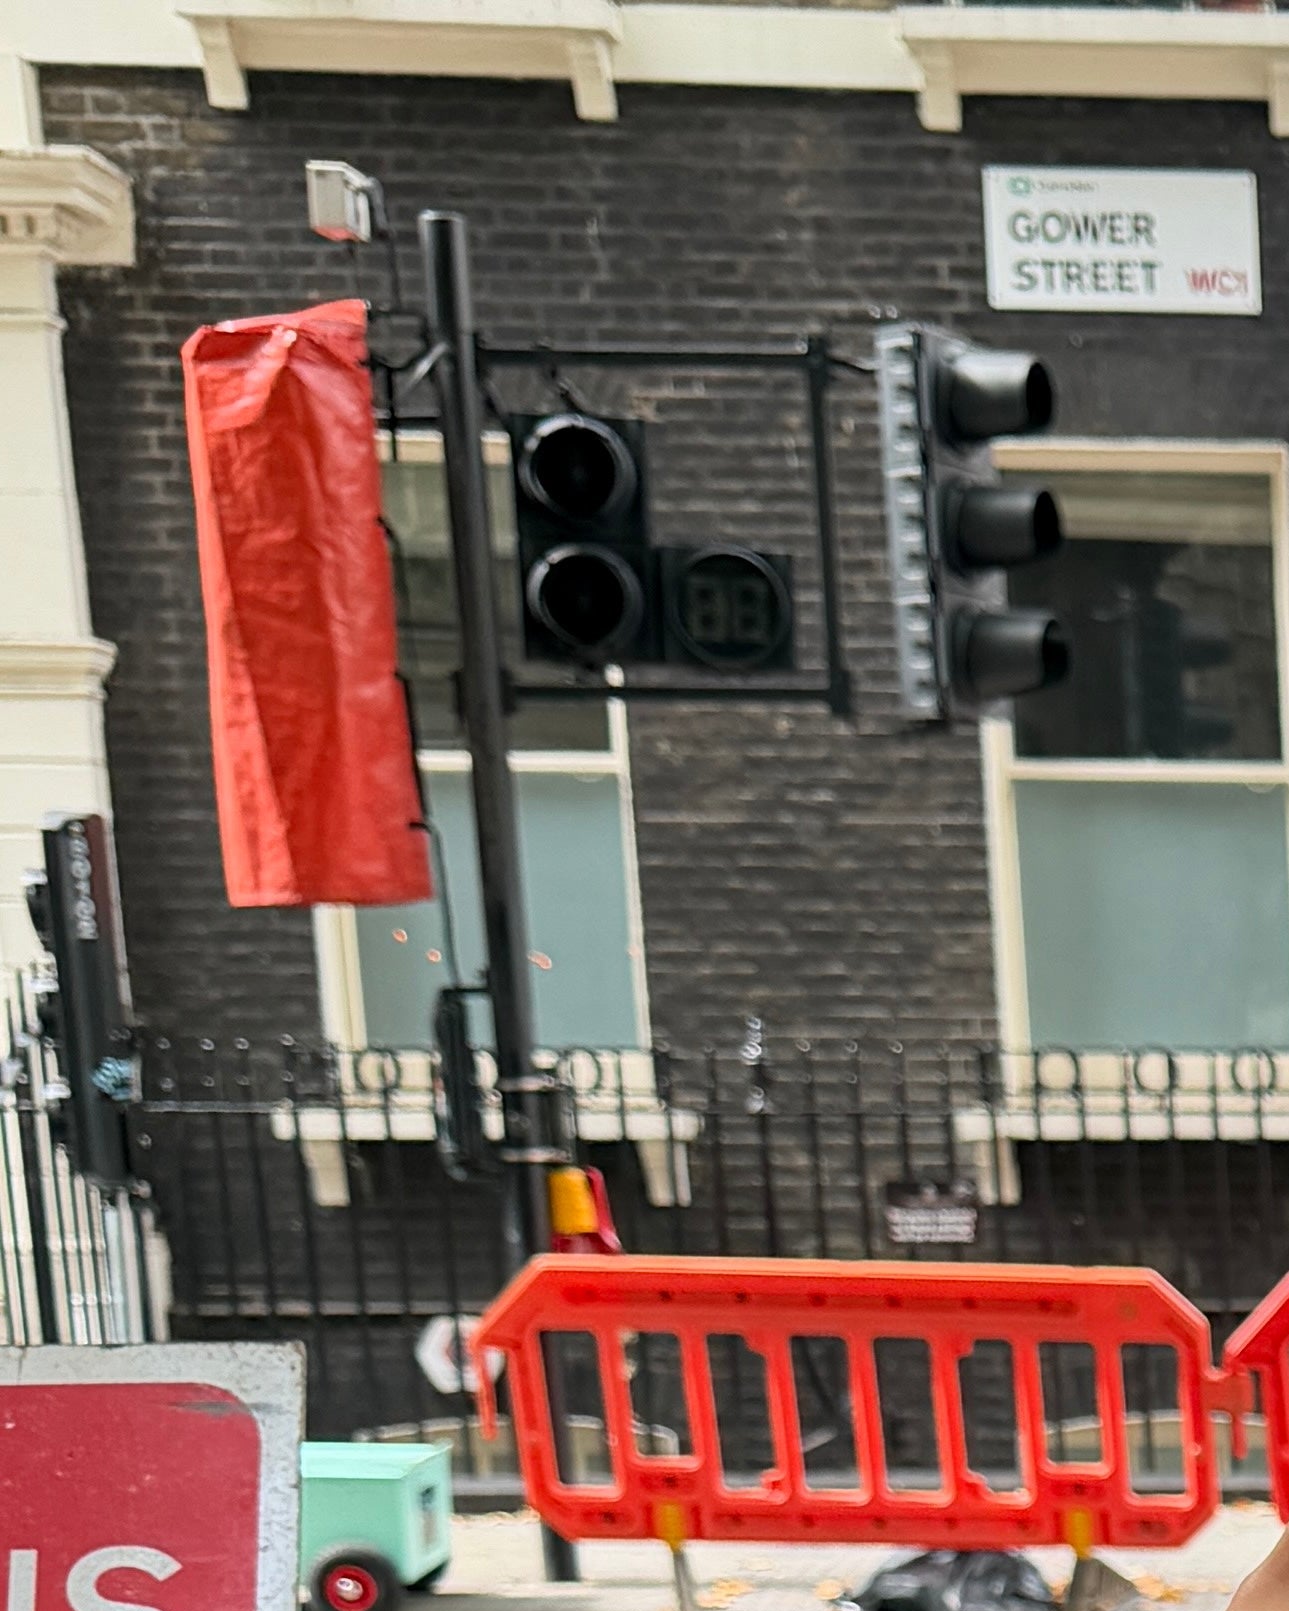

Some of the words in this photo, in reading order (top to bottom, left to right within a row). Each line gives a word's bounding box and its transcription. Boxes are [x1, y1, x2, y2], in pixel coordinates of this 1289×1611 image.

[1007, 210, 1157, 247] GOWER
[1012, 258, 1160, 295] STREET
[1184, 266, 1248, 296] WC1
